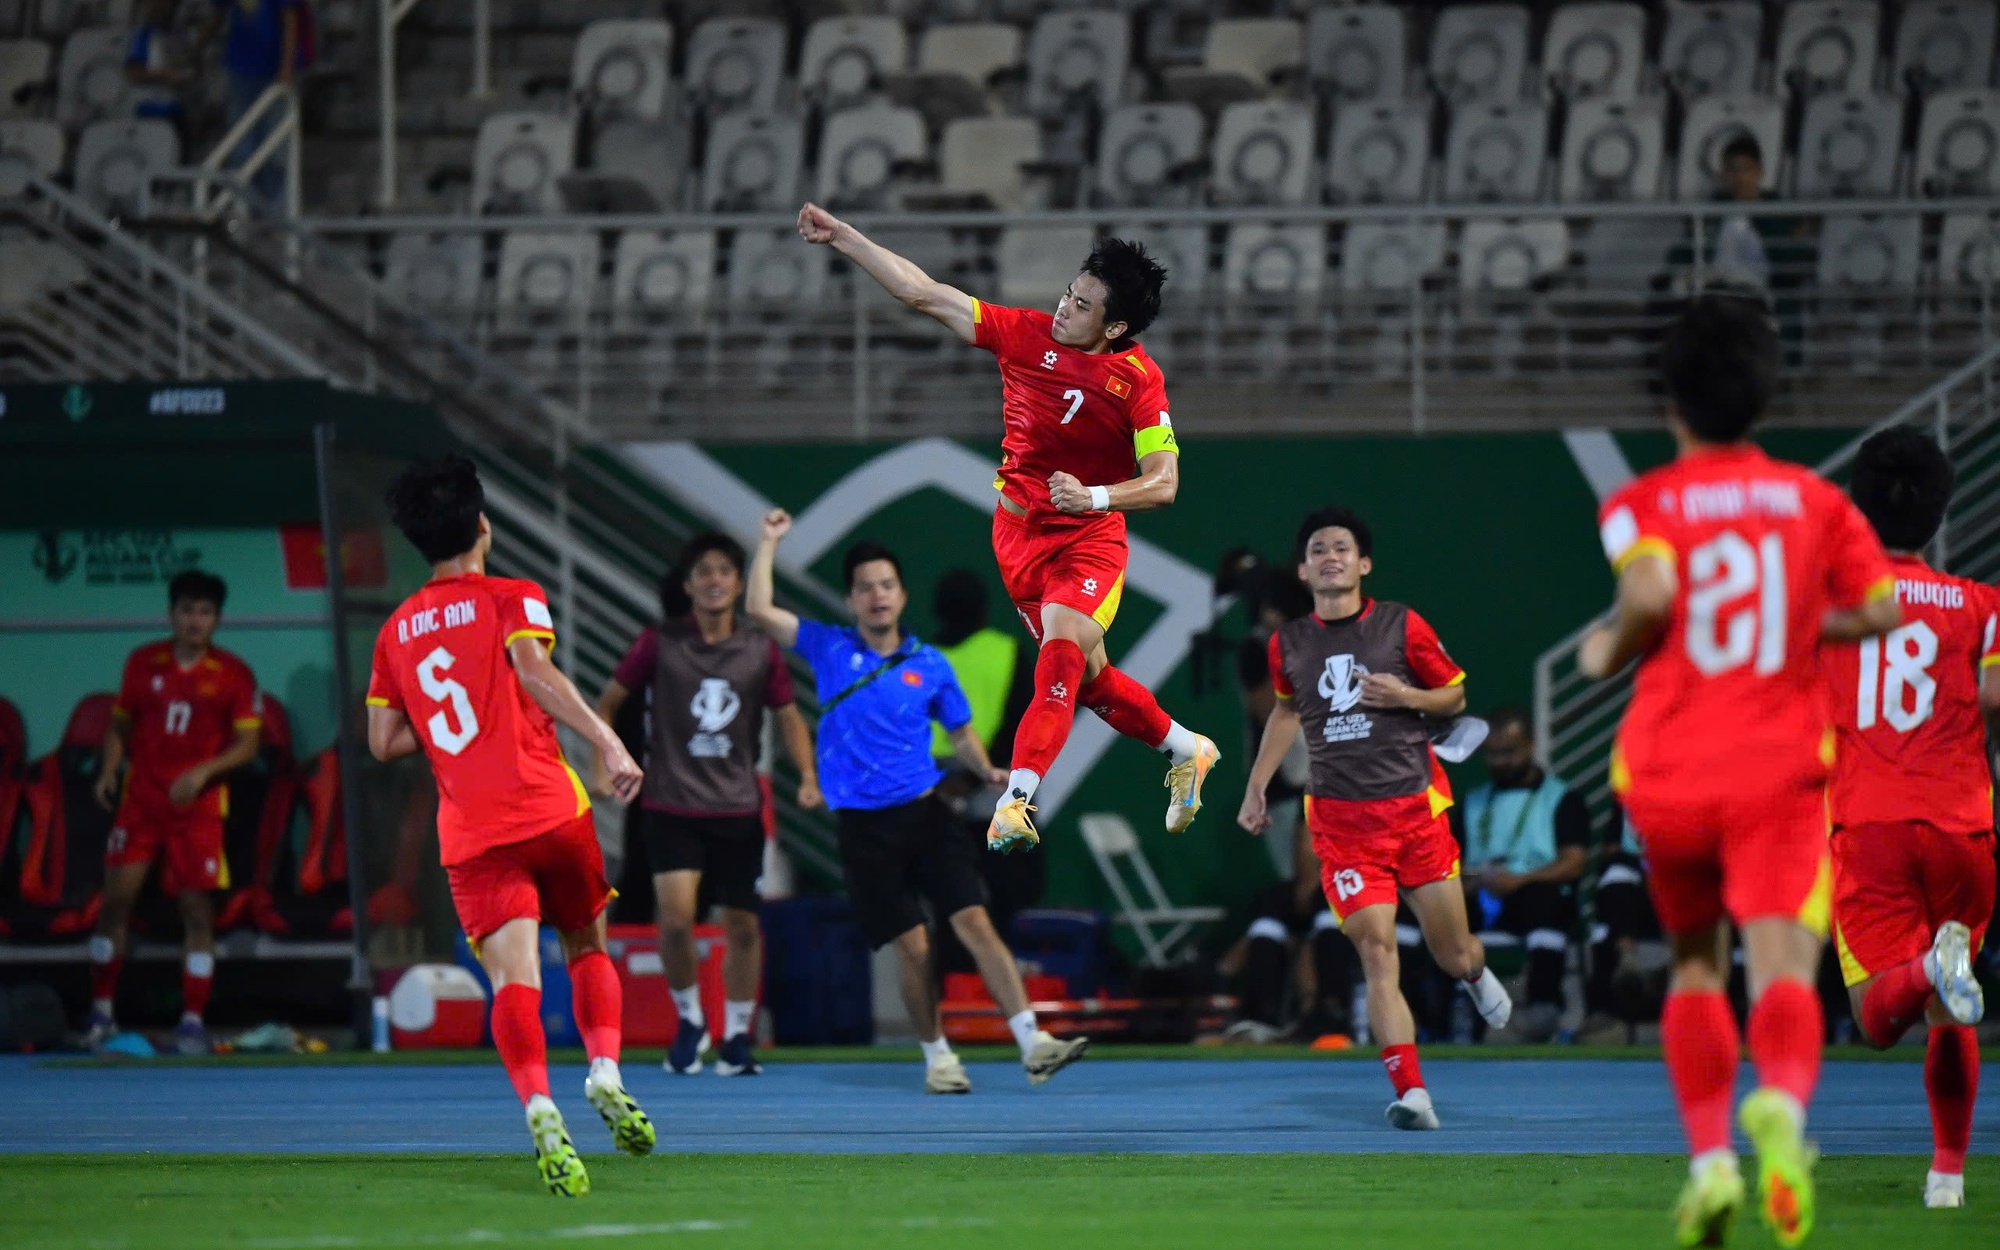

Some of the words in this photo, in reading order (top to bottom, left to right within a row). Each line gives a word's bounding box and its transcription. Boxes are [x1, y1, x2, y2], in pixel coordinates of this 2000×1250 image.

[1060, 389, 1085, 424] 7
[1687, 531, 1786, 676] 21
[165, 701, 192, 735] 17
[416, 645, 480, 756] 5
[1857, 618, 1938, 733] 18
